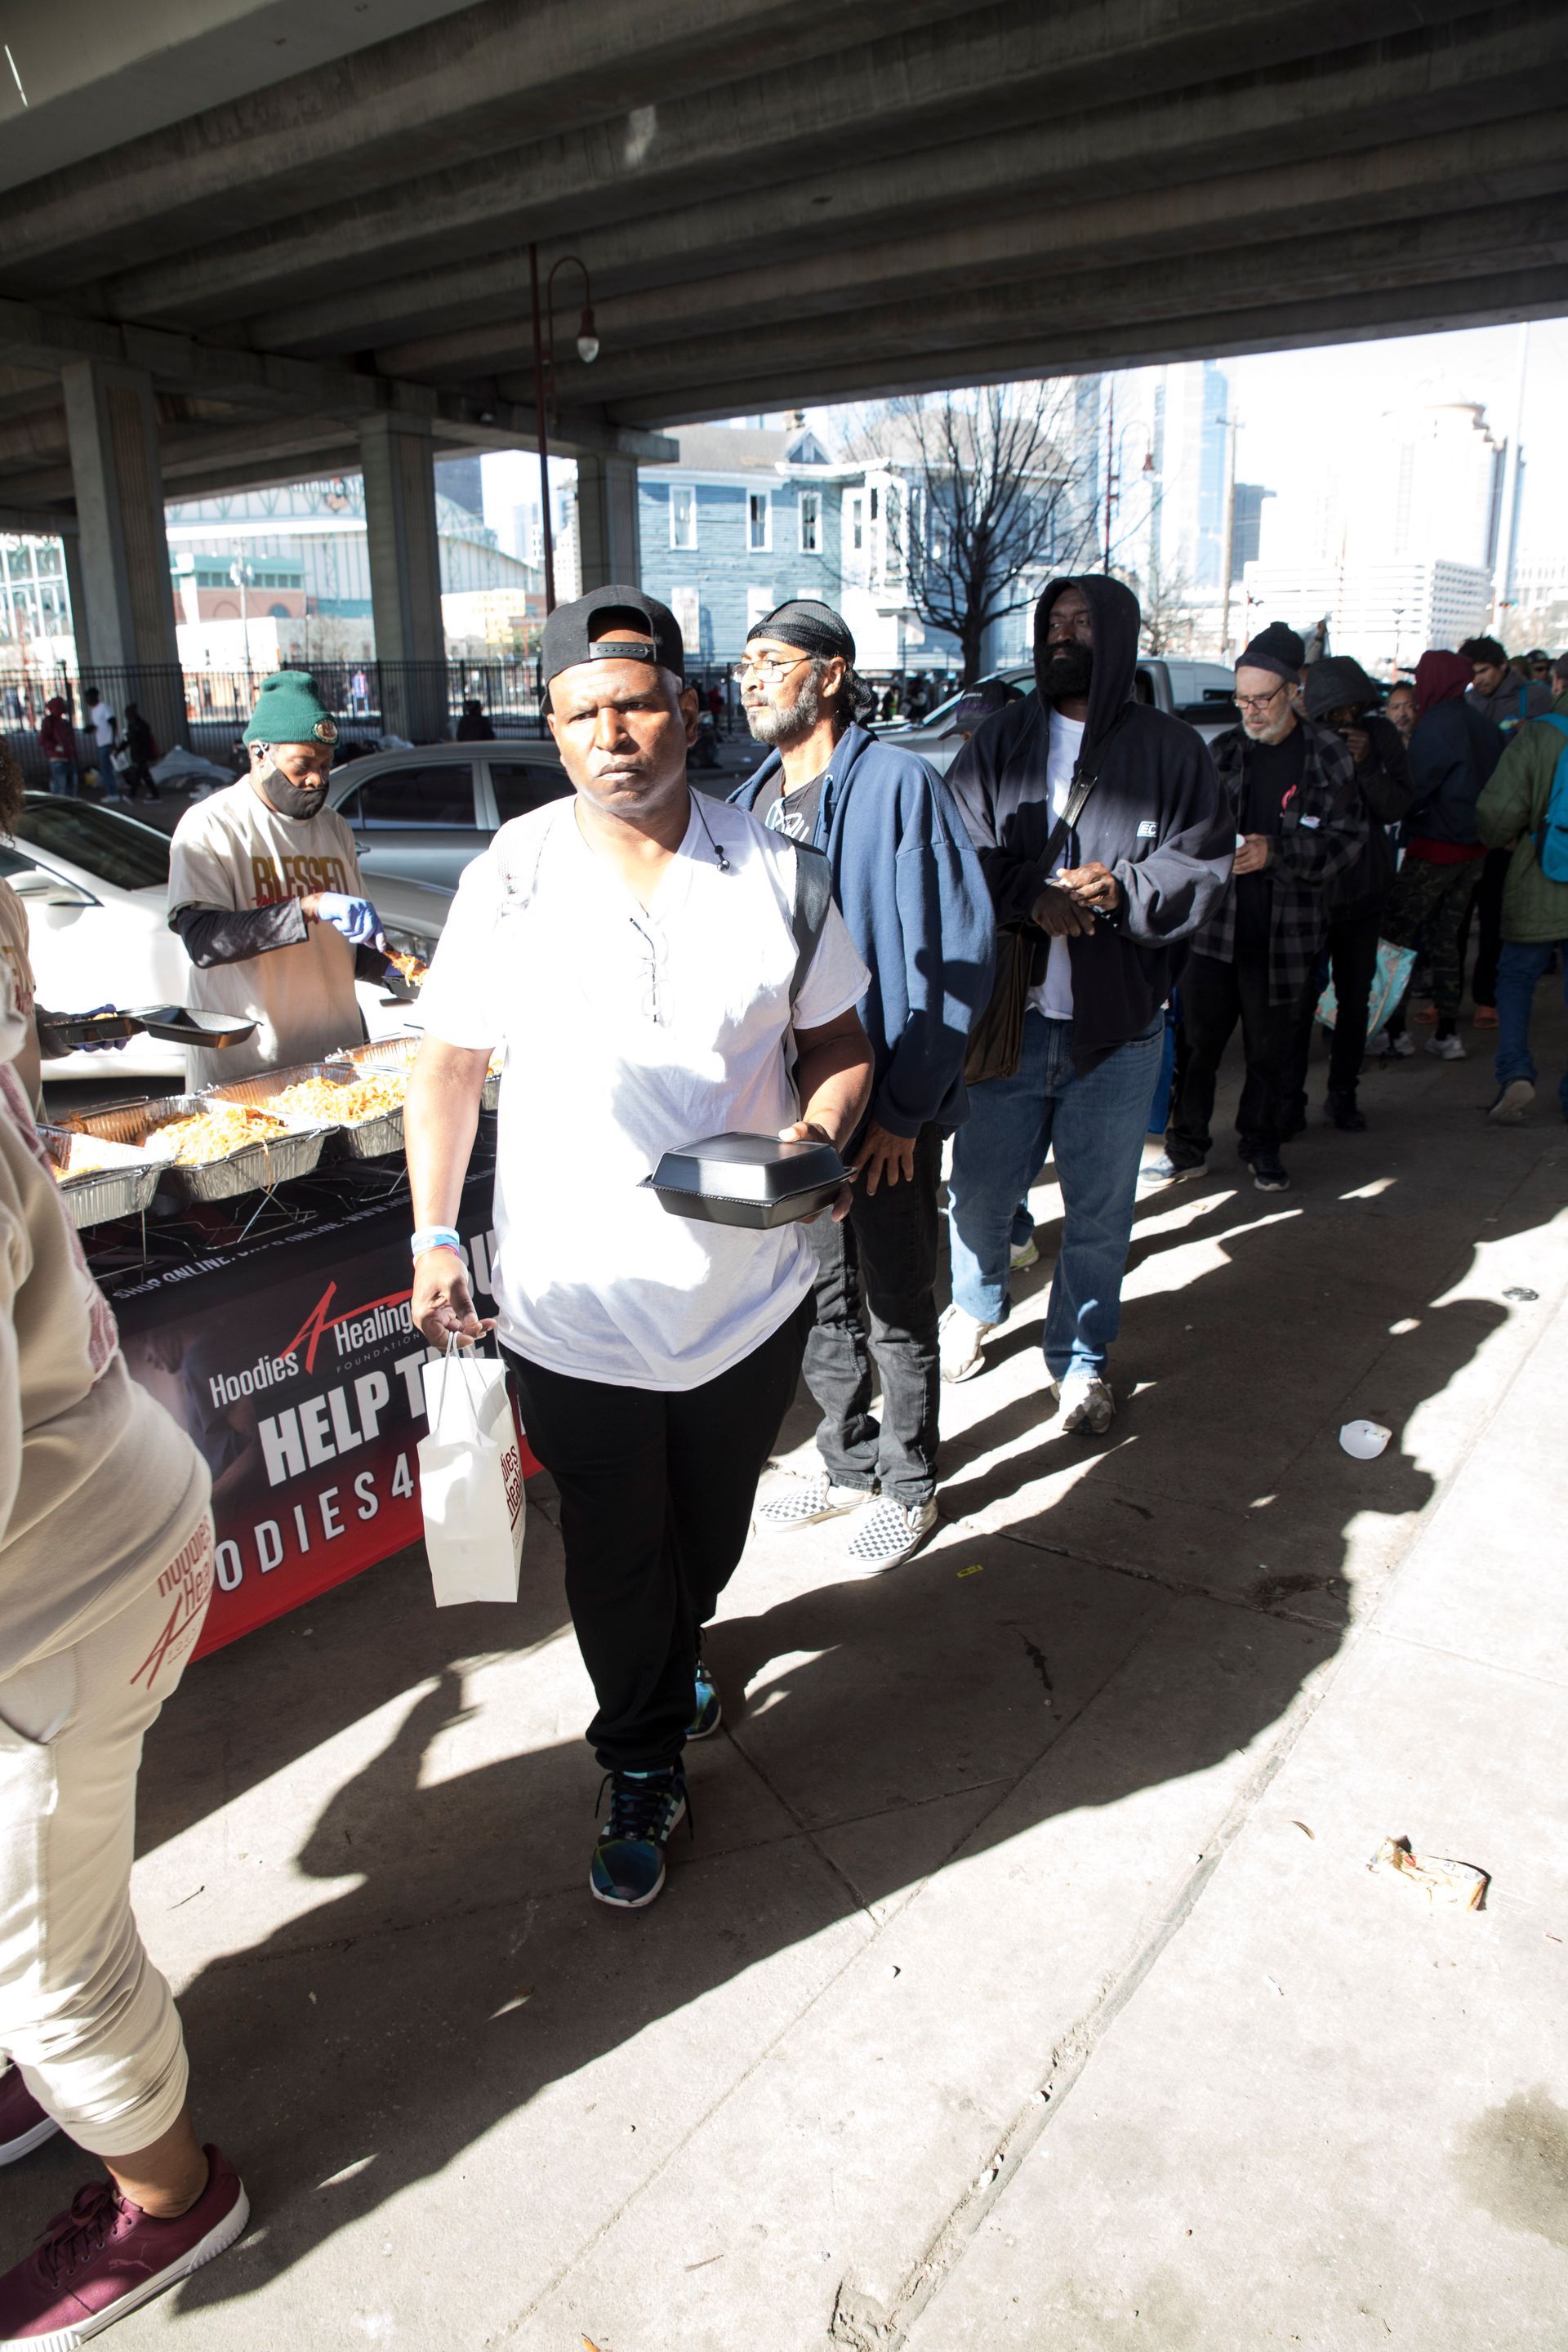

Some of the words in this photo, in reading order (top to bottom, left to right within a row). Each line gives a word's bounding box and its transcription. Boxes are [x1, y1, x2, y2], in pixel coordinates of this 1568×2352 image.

[252, 855, 350, 900] BLESSED
[112, 1277, 163, 1299] SHOP
[208, 1352, 300, 1409] Hoodies
[333, 1300, 414, 1356] Healing
[336, 1331, 421, 1374] FOUNDATION
[257, 1370, 390, 1487] HELP
